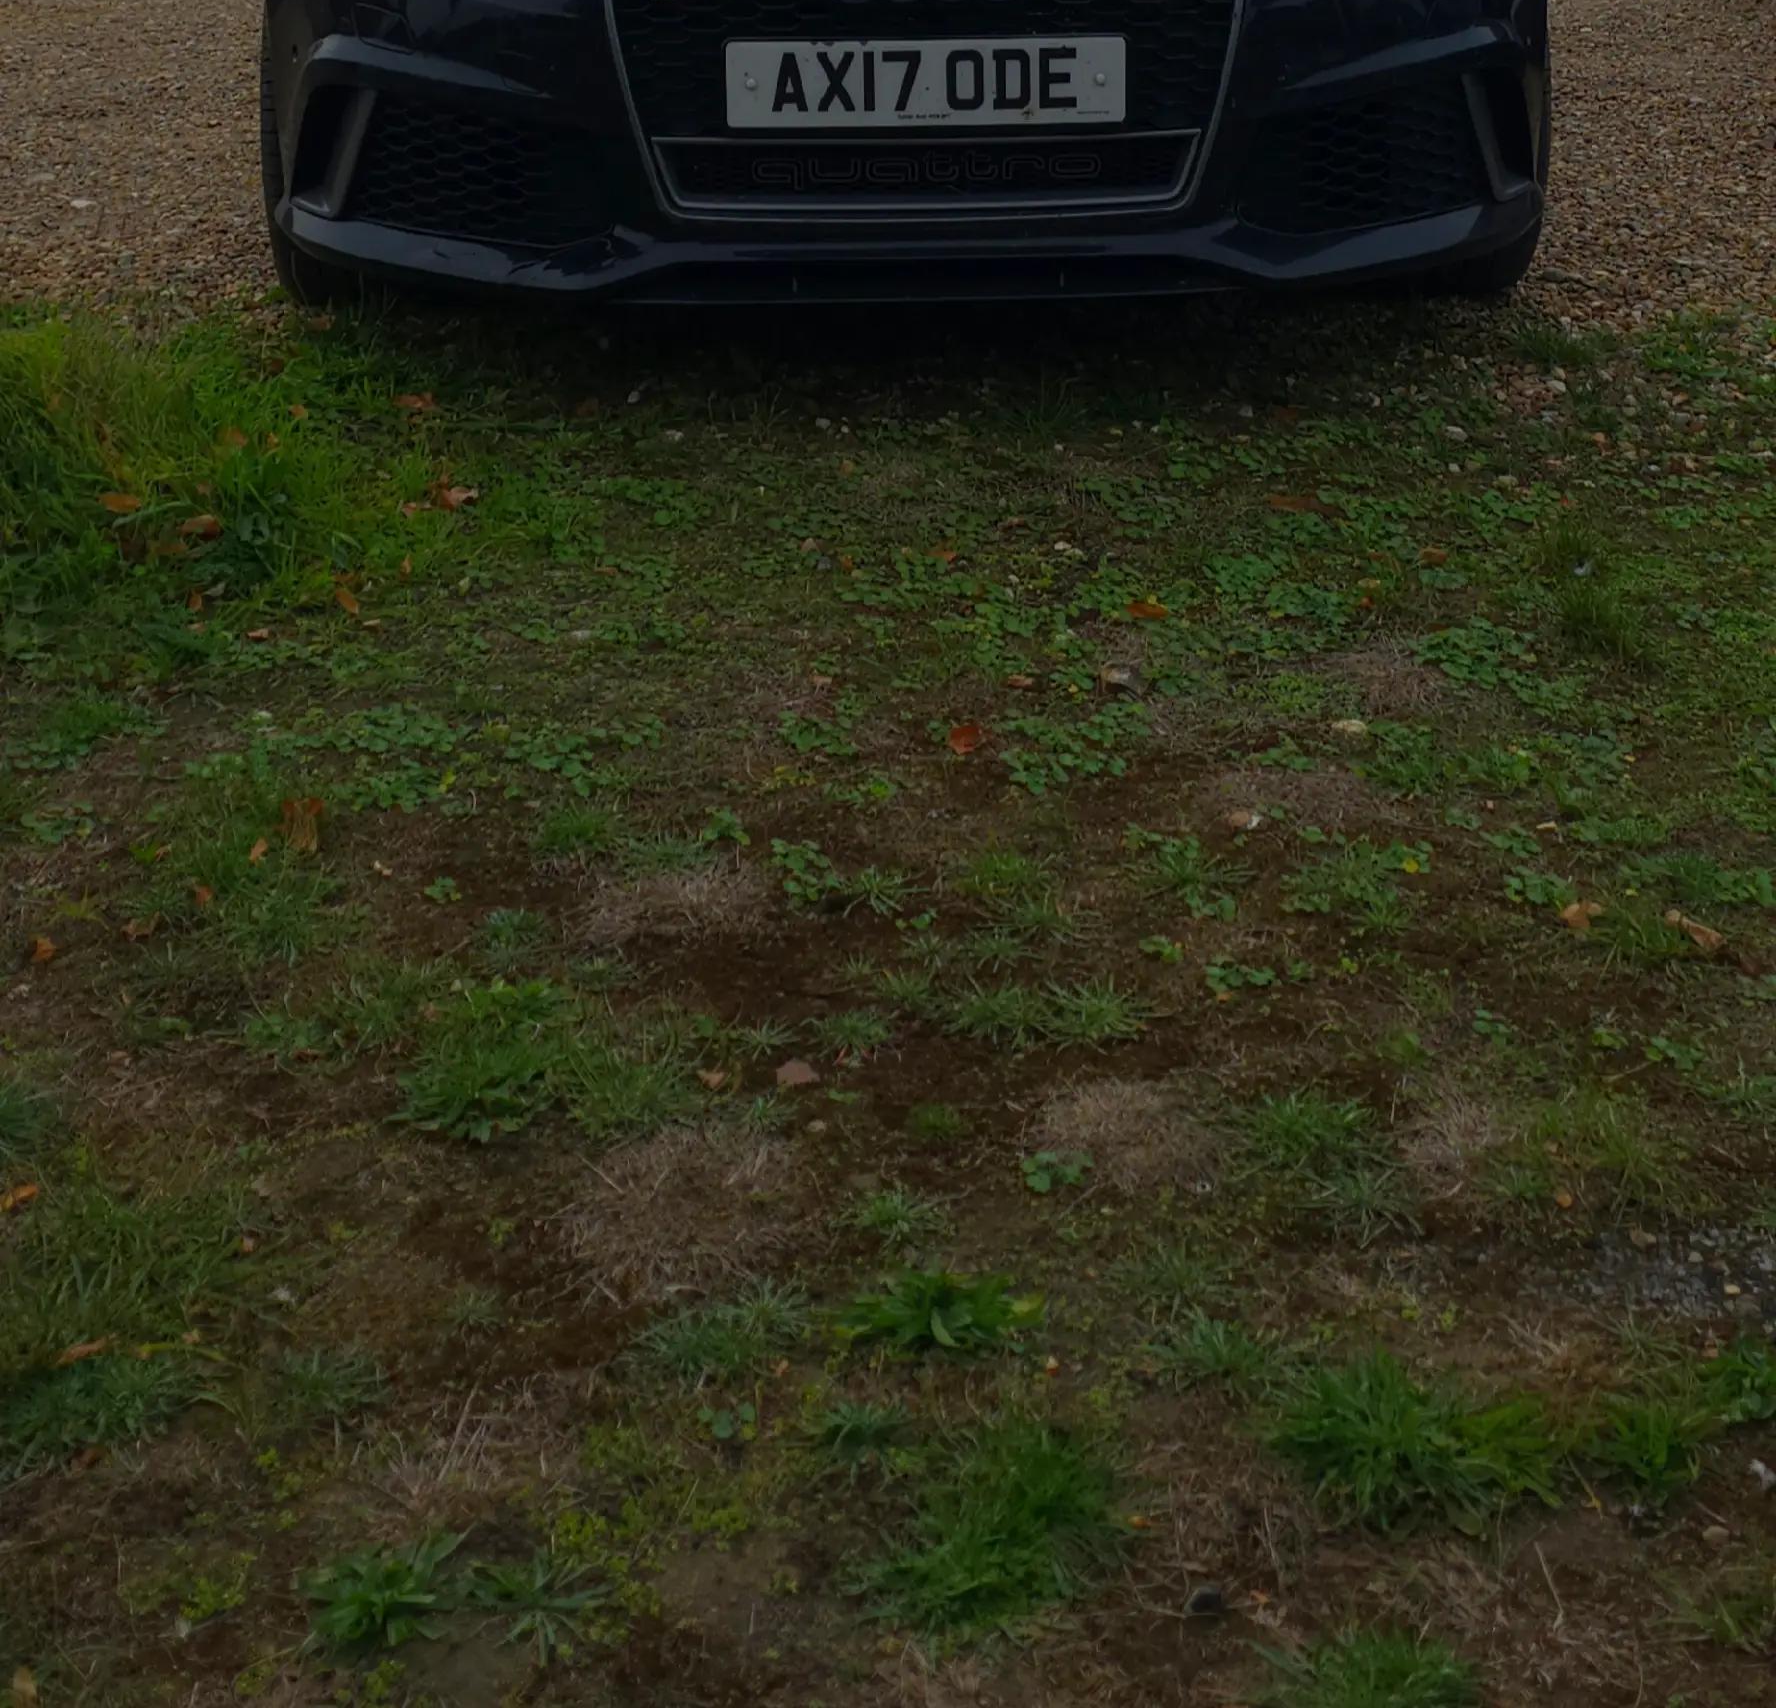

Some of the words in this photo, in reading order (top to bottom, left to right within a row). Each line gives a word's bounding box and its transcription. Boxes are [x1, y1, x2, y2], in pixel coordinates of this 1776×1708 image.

[772, 50, 922, 112] AX17
[945, 47, 1078, 111] ODE
[752, 149, 1101, 191] quattro
